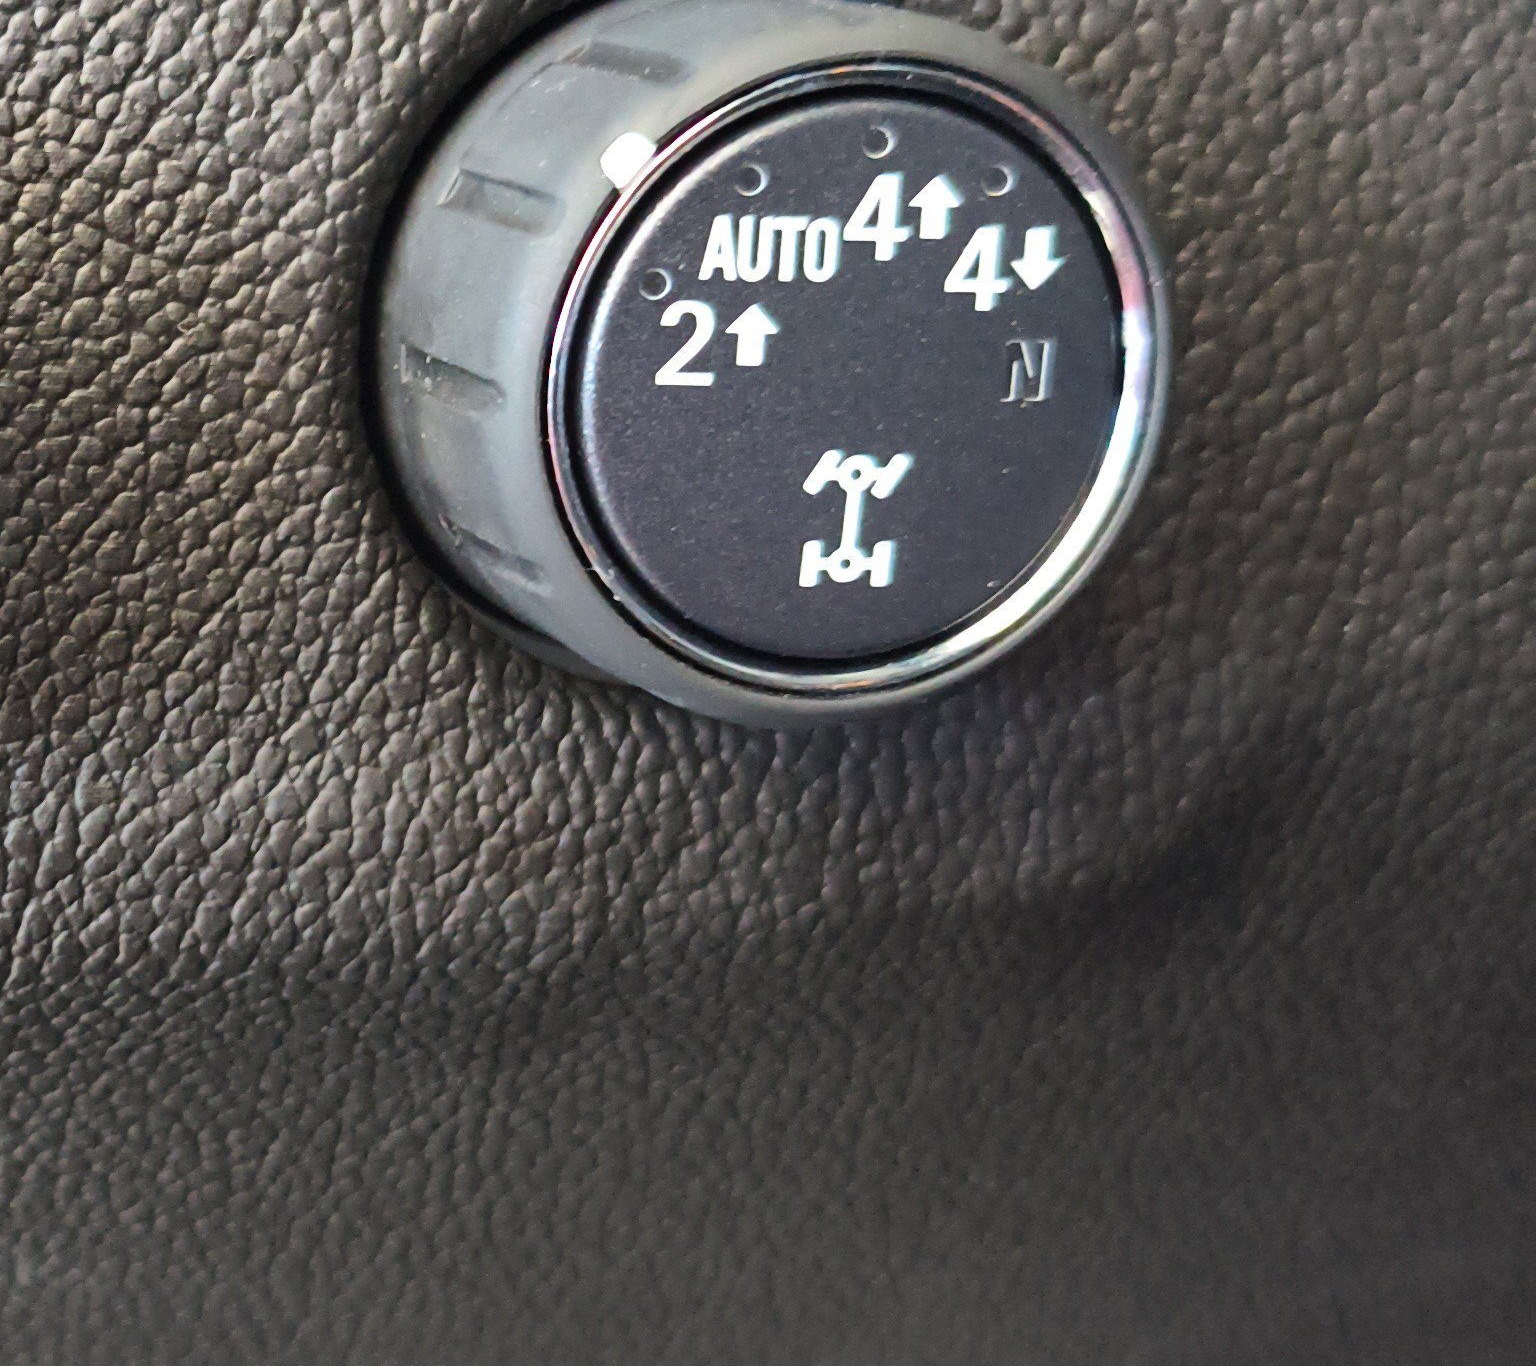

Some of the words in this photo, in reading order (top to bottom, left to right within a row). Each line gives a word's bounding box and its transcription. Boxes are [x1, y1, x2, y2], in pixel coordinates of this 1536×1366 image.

[698, 214, 843, 282] AUTO
[843, 172, 910, 261] 4
[944, 225, 1012, 311] 4
[654, 300, 716, 387] 2
[1000, 338, 1057, 402] N
